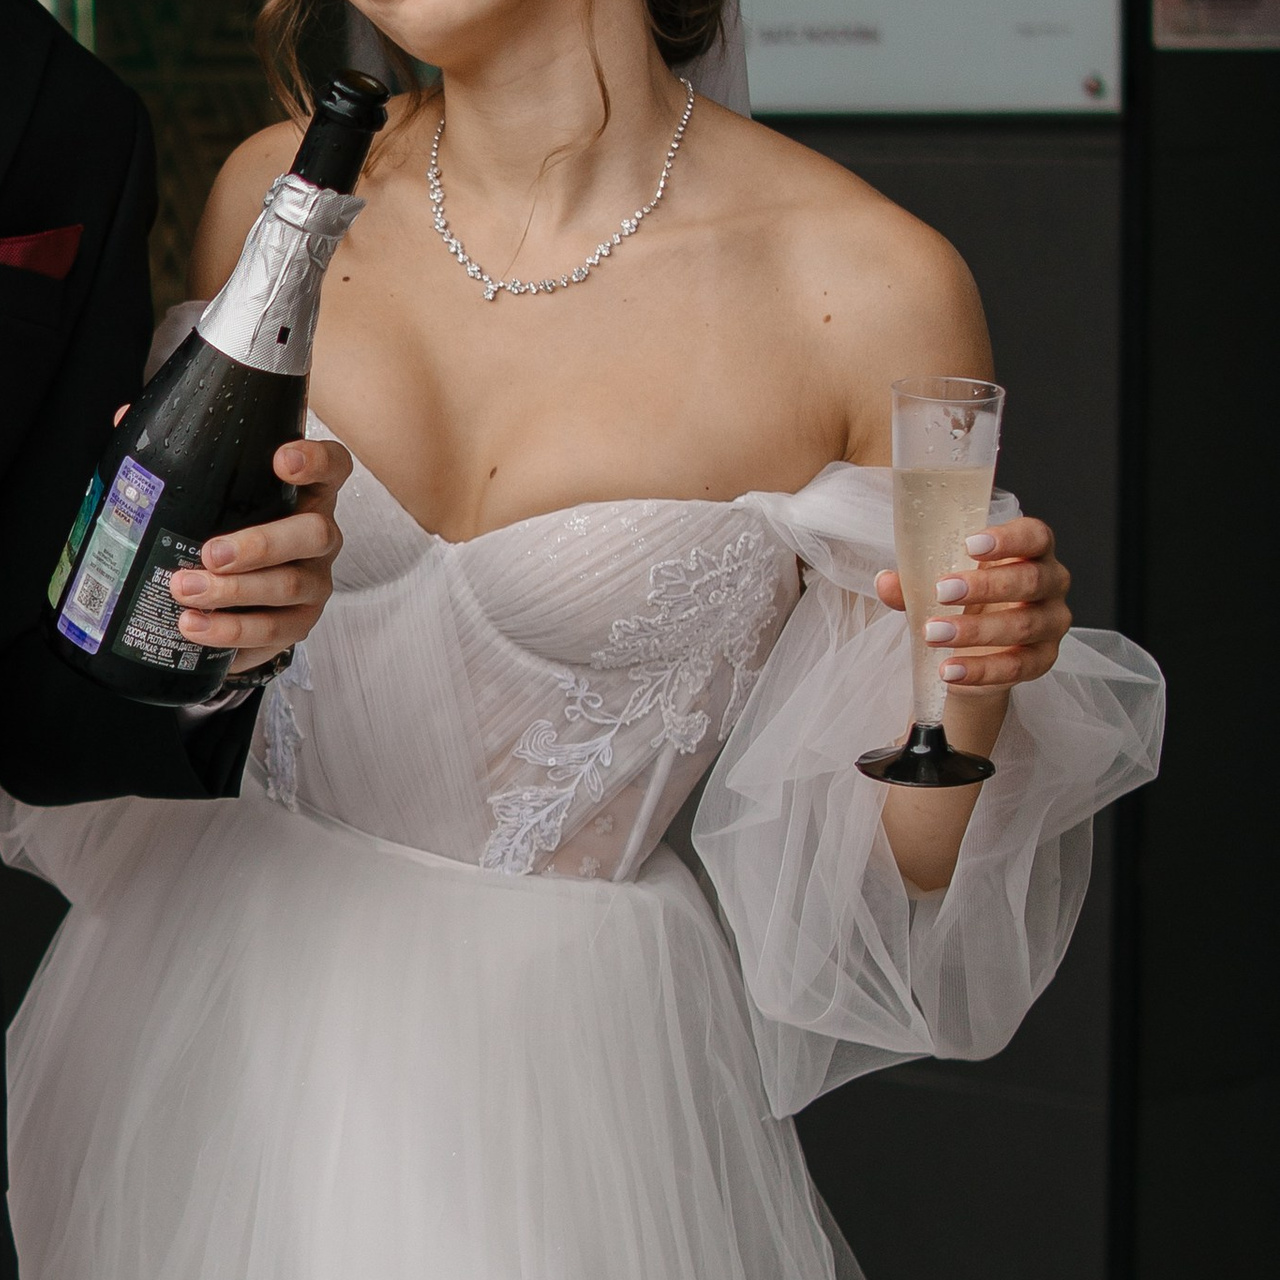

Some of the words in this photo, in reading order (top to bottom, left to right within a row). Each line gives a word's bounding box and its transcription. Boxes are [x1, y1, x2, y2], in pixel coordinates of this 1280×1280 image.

[122, 471, 154, 496] ФЕДЕРАЦИЯ
[124, 465, 156, 491] РОССИЙСКАЯ
[175, 542, 187, 551] DI
[188, 546, 202, 556] CA
[128, 616, 146, 628] МЕСТО
[122, 634, 134, 646] ГОД
[147, 633, 180, 649] РЕСПУБЛИКА
